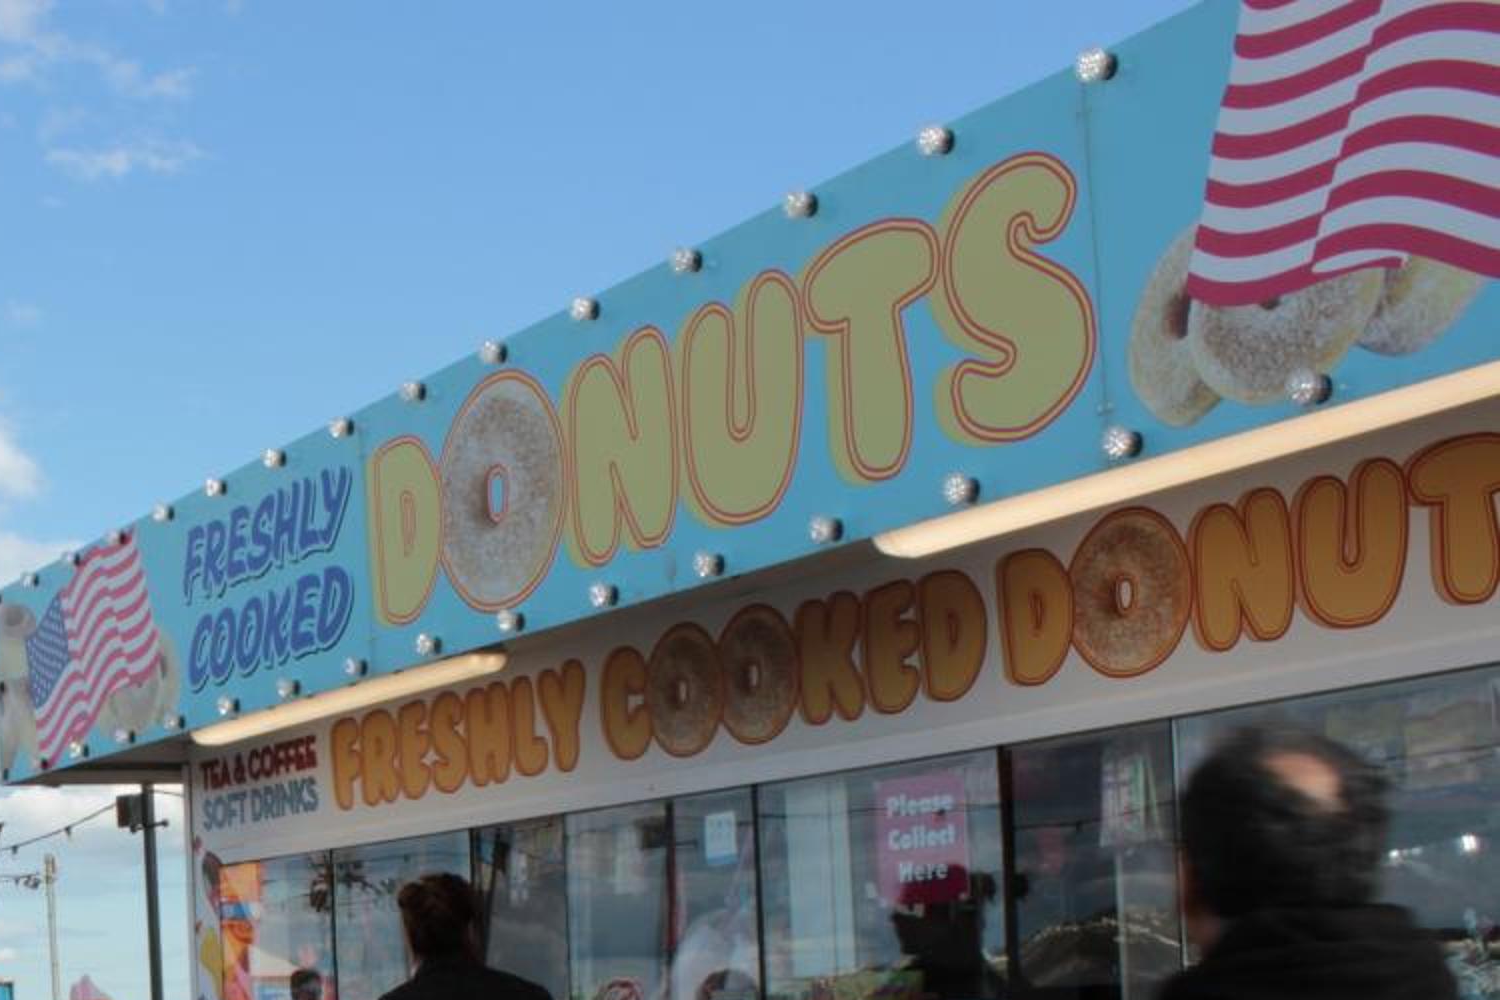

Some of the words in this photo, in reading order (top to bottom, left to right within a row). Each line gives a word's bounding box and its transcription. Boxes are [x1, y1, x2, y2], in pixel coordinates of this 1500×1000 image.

[369, 151, 1097, 626] DONUTS
[183, 466, 352, 606] FRESHLY
[187, 565, 354, 694] COOKED
[330, 658, 586, 811] FRESHLY
[601, 569, 988, 760] COOKED
[200, 758, 231, 790] TEA
[234, 752, 246, 784] &
[248, 735, 318, 781] COFFEE
[202, 791, 247, 831] SOFT
[250, 776, 319, 822] DRINKS
[885, 794, 954, 818] Please
[887, 824, 956, 850] Collect
[899, 862, 949, 882] Here
